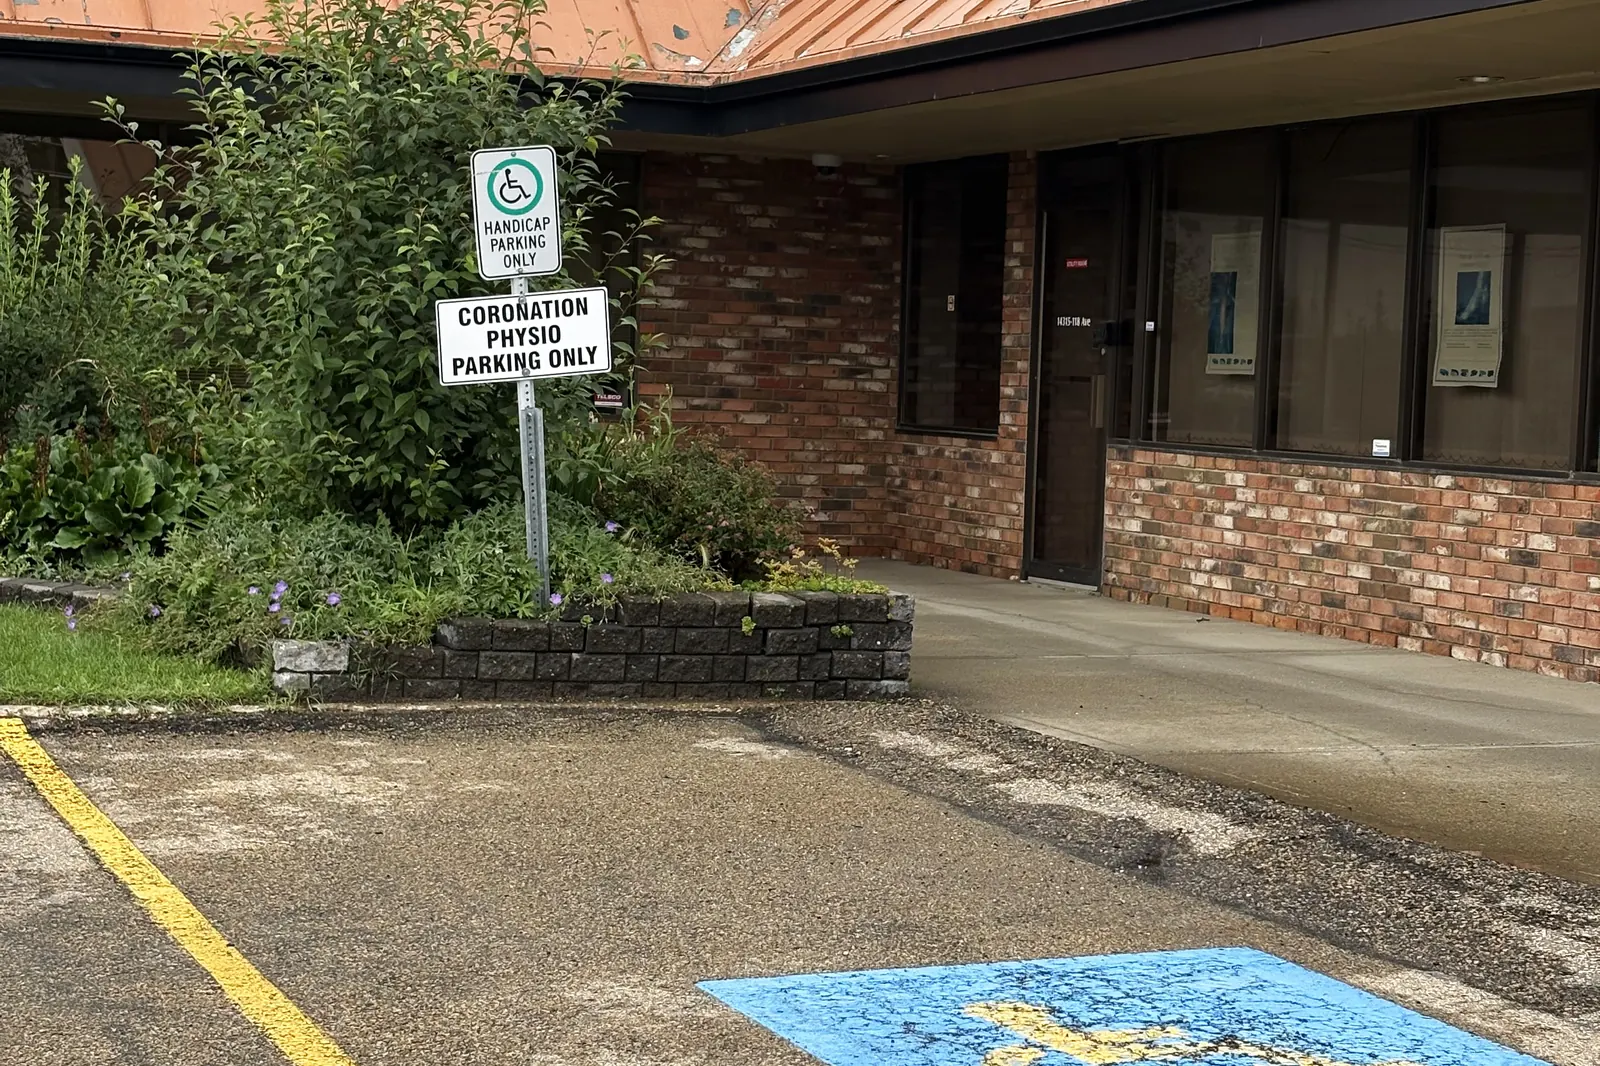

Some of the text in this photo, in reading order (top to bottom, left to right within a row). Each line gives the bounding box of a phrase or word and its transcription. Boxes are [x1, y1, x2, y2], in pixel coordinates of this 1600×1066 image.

[484, 217, 551, 235] HANDICAP
[490, 234, 546, 252] PARKING
[503, 252, 537, 269] ONLY
[458, 296, 588, 326] CORONATION
[487, 324, 561, 349] PHYSIO
[452, 346, 598, 376] PARKING ONLY
